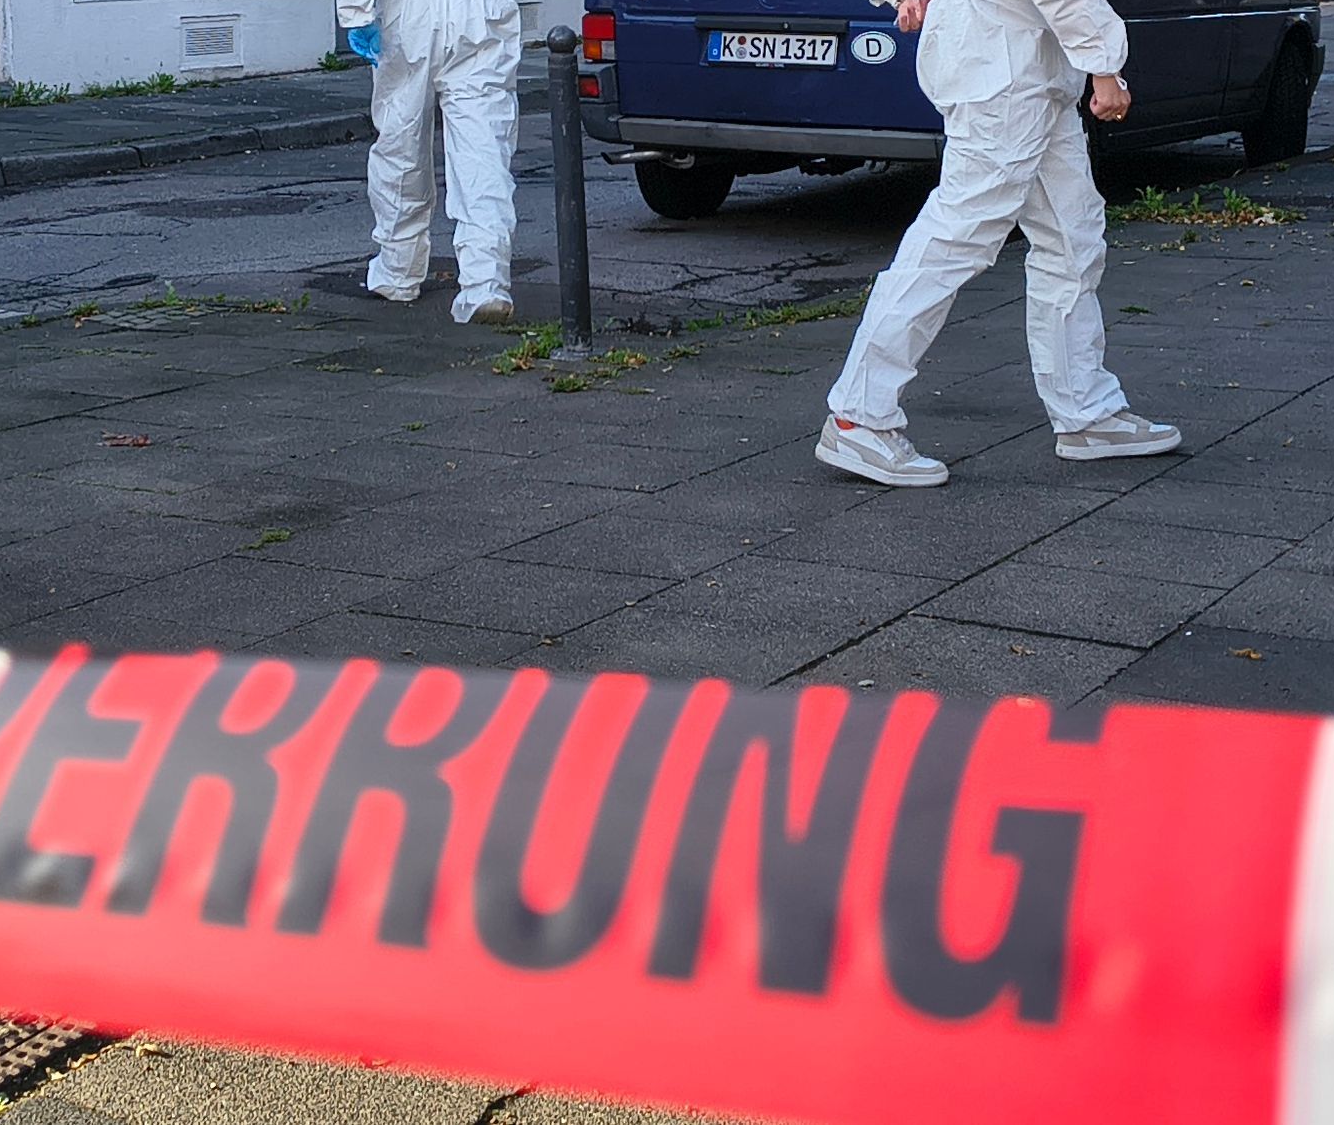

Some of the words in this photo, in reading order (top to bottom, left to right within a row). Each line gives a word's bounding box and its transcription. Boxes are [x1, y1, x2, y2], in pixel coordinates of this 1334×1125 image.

[722, 36, 735, 58] K
[780, 38, 833, 61] 1317
[865, 38, 882, 57] D
